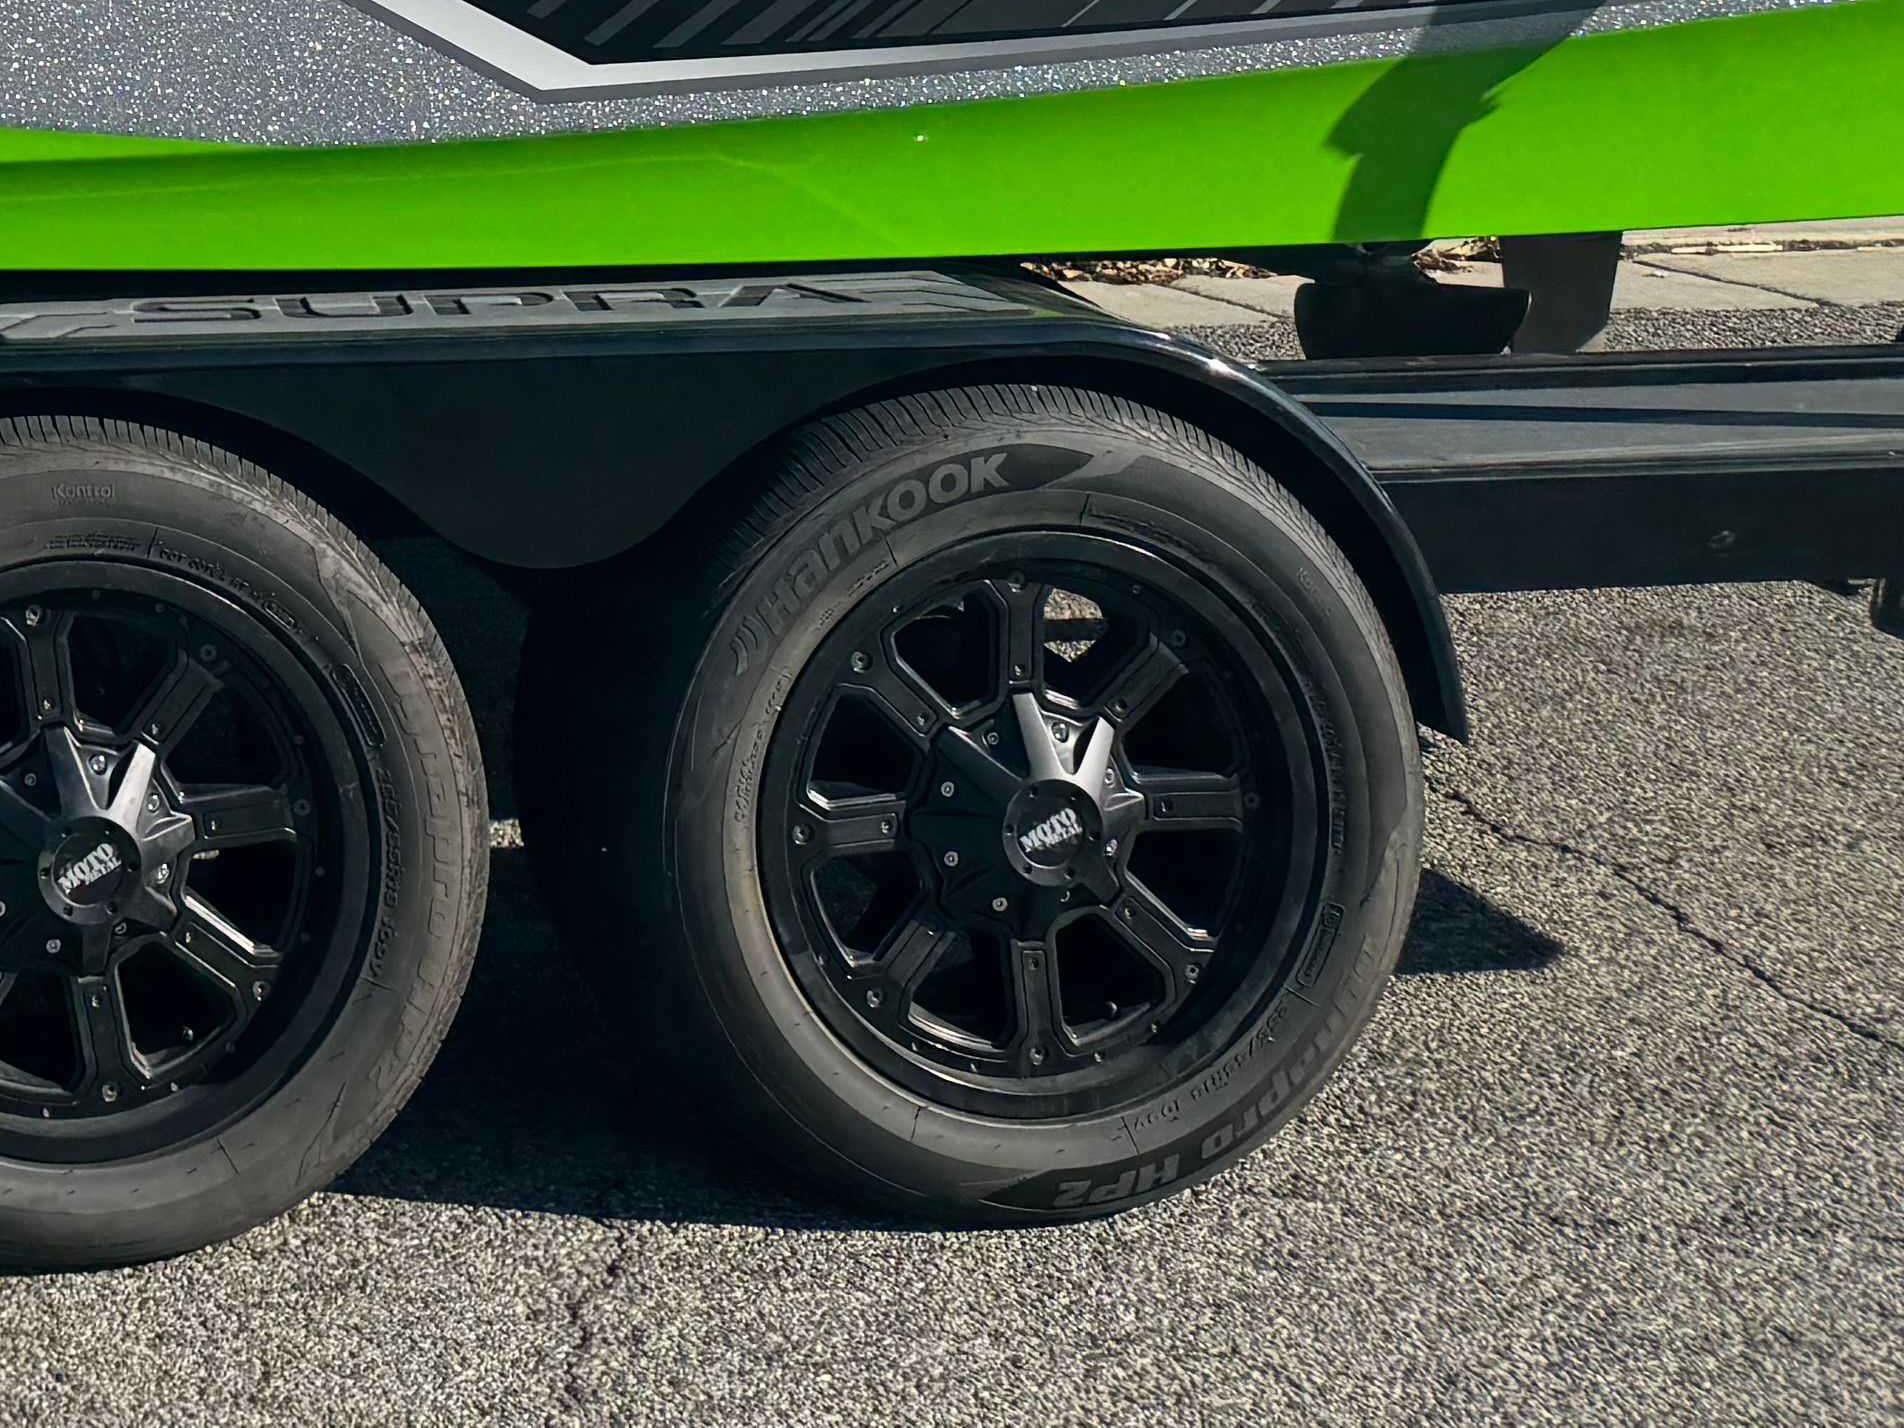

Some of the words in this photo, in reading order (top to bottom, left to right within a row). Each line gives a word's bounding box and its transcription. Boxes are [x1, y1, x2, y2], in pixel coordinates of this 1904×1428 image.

[132, 280, 874, 324] SUPRA
[1019, 806, 1077, 853] MOTO
[57, 841, 114, 895] MOTO
[1051, 1152, 1181, 1208] HP2
